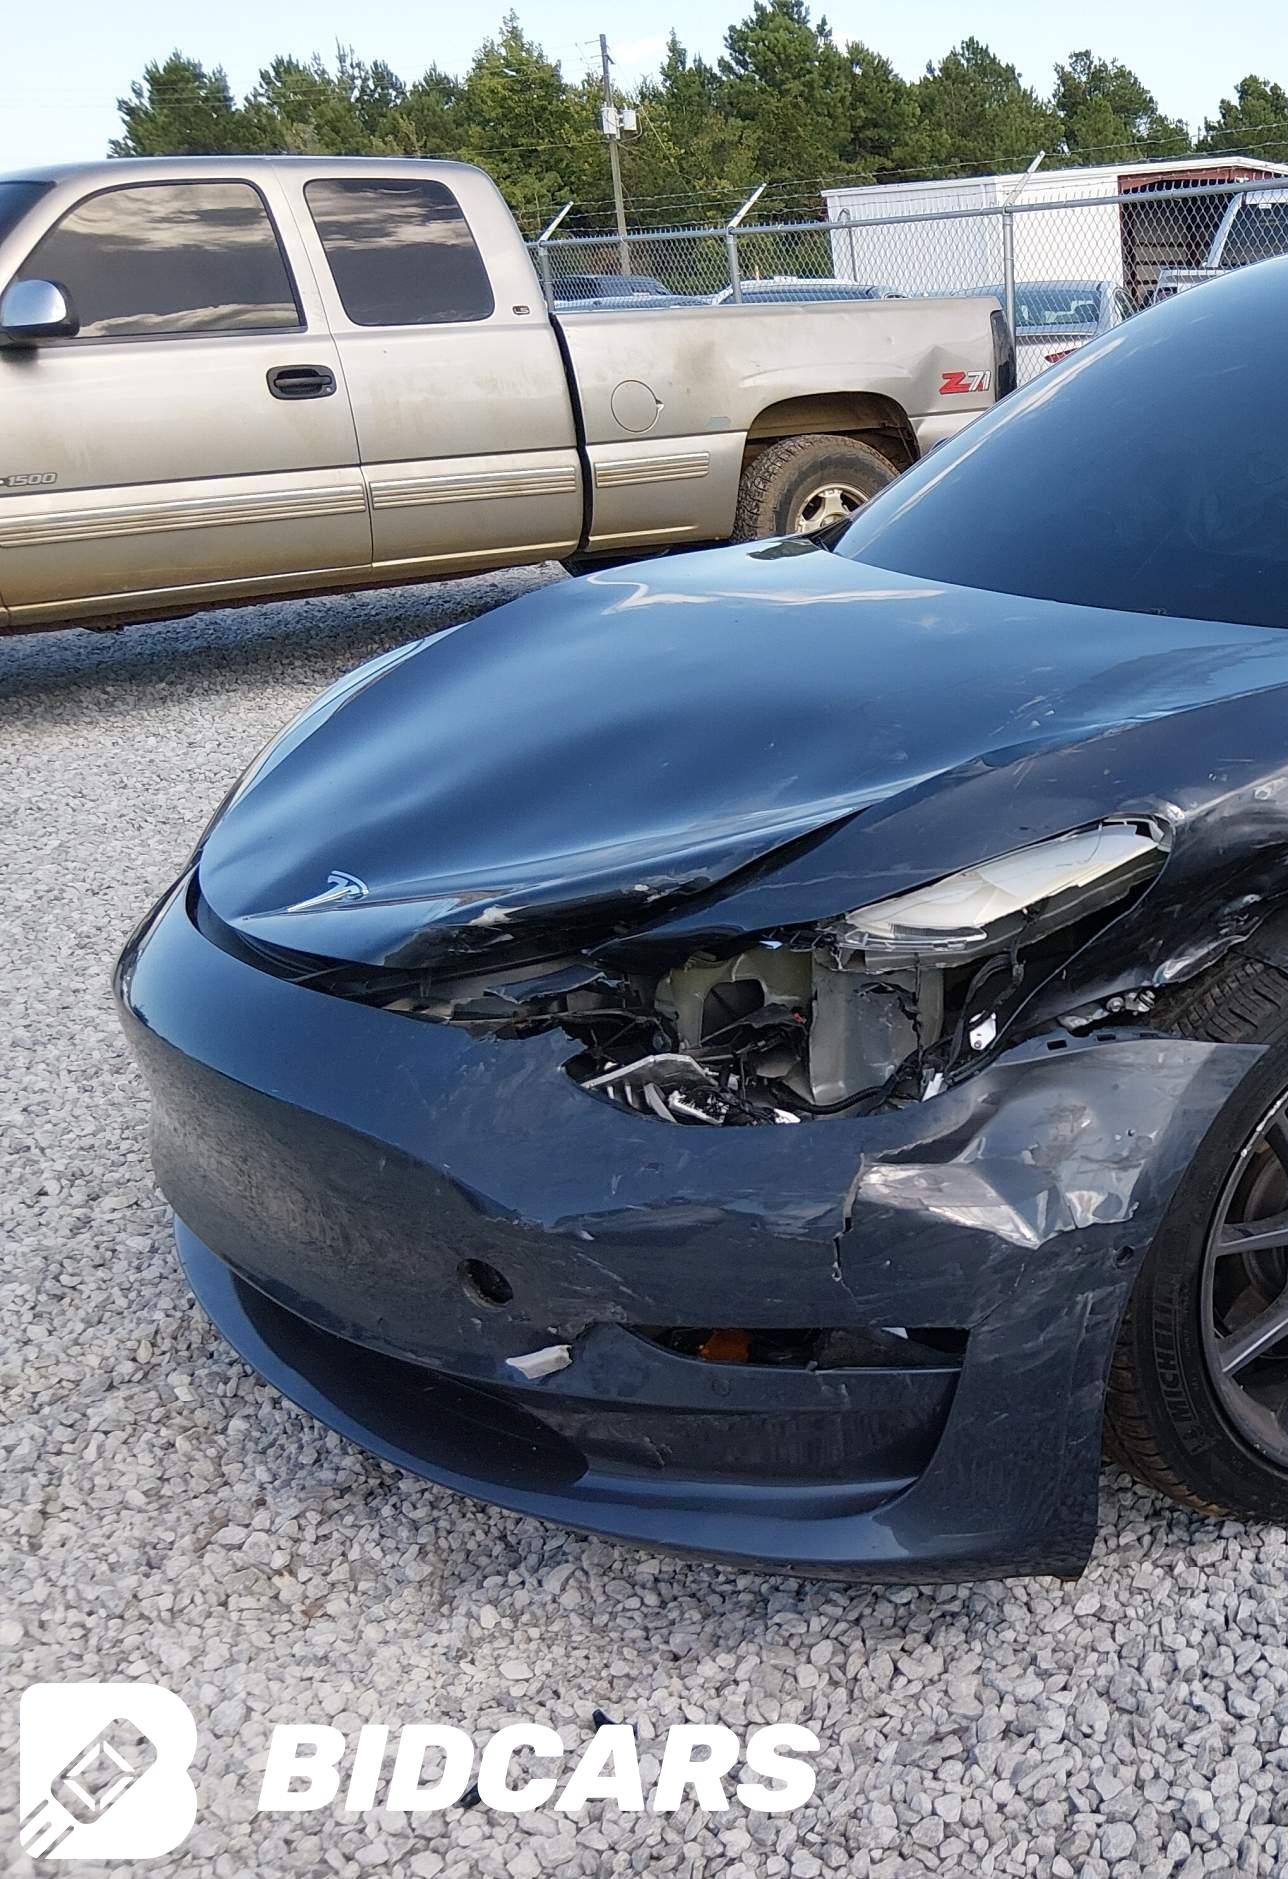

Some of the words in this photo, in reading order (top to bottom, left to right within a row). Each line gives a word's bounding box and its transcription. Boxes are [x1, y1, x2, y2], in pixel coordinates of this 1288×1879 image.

[939, 370, 991, 394] Z71
[8, 472, 57, 487] 1500
[1153, 1290, 1193, 1424] MICHELI
